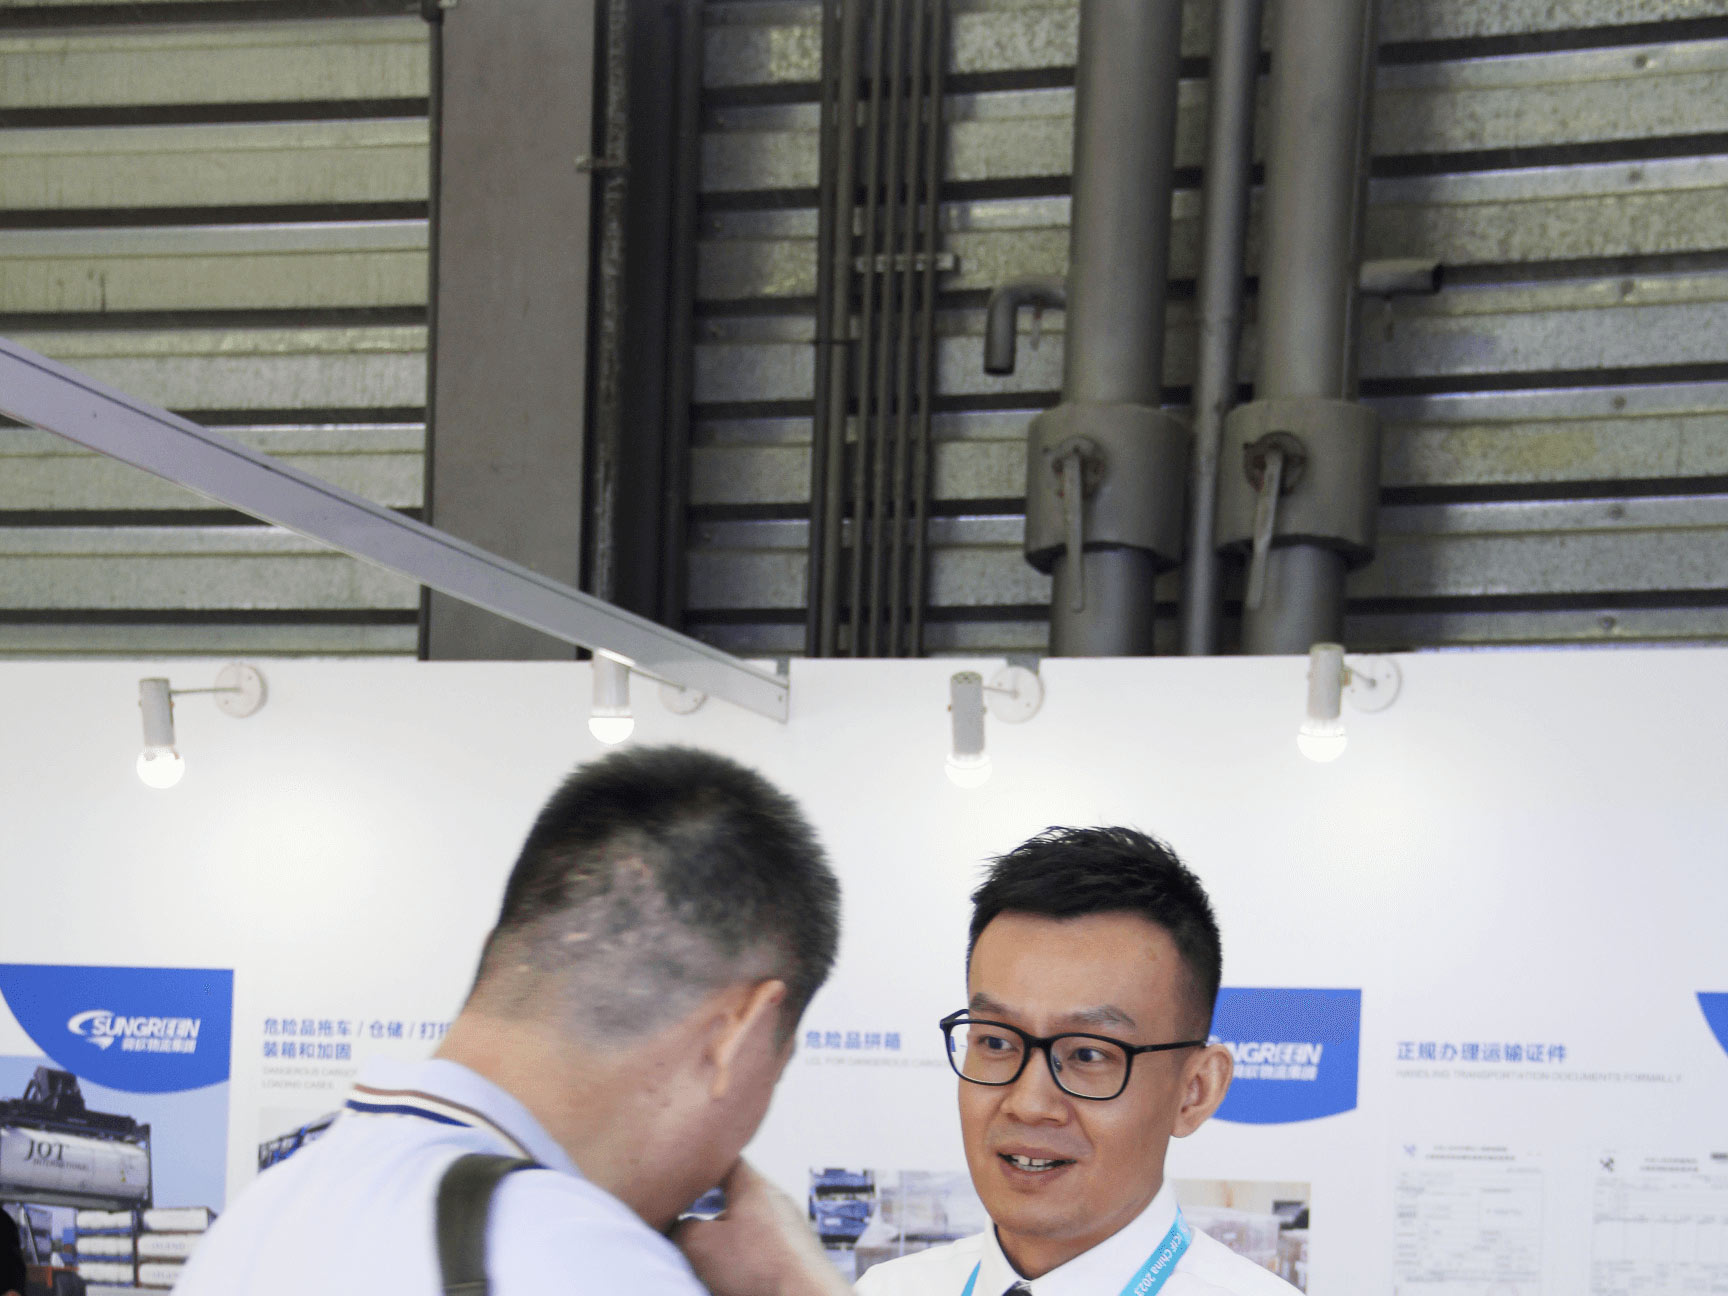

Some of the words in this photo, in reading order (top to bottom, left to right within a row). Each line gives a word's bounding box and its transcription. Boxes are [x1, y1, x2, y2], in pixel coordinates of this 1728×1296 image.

[263, 1017, 353, 1037] 危险品拖车
[369, 1020, 404, 1039] 仓储
[263, 1041, 353, 1060] 装箱和加固
[1396, 1040, 1568, 1064] 正规办理运输证件
[24, 1139, 70, 1161] JOT
[1150, 1248, 1173, 1275] China
[1134, 1272, 1157, 1296] 2023
